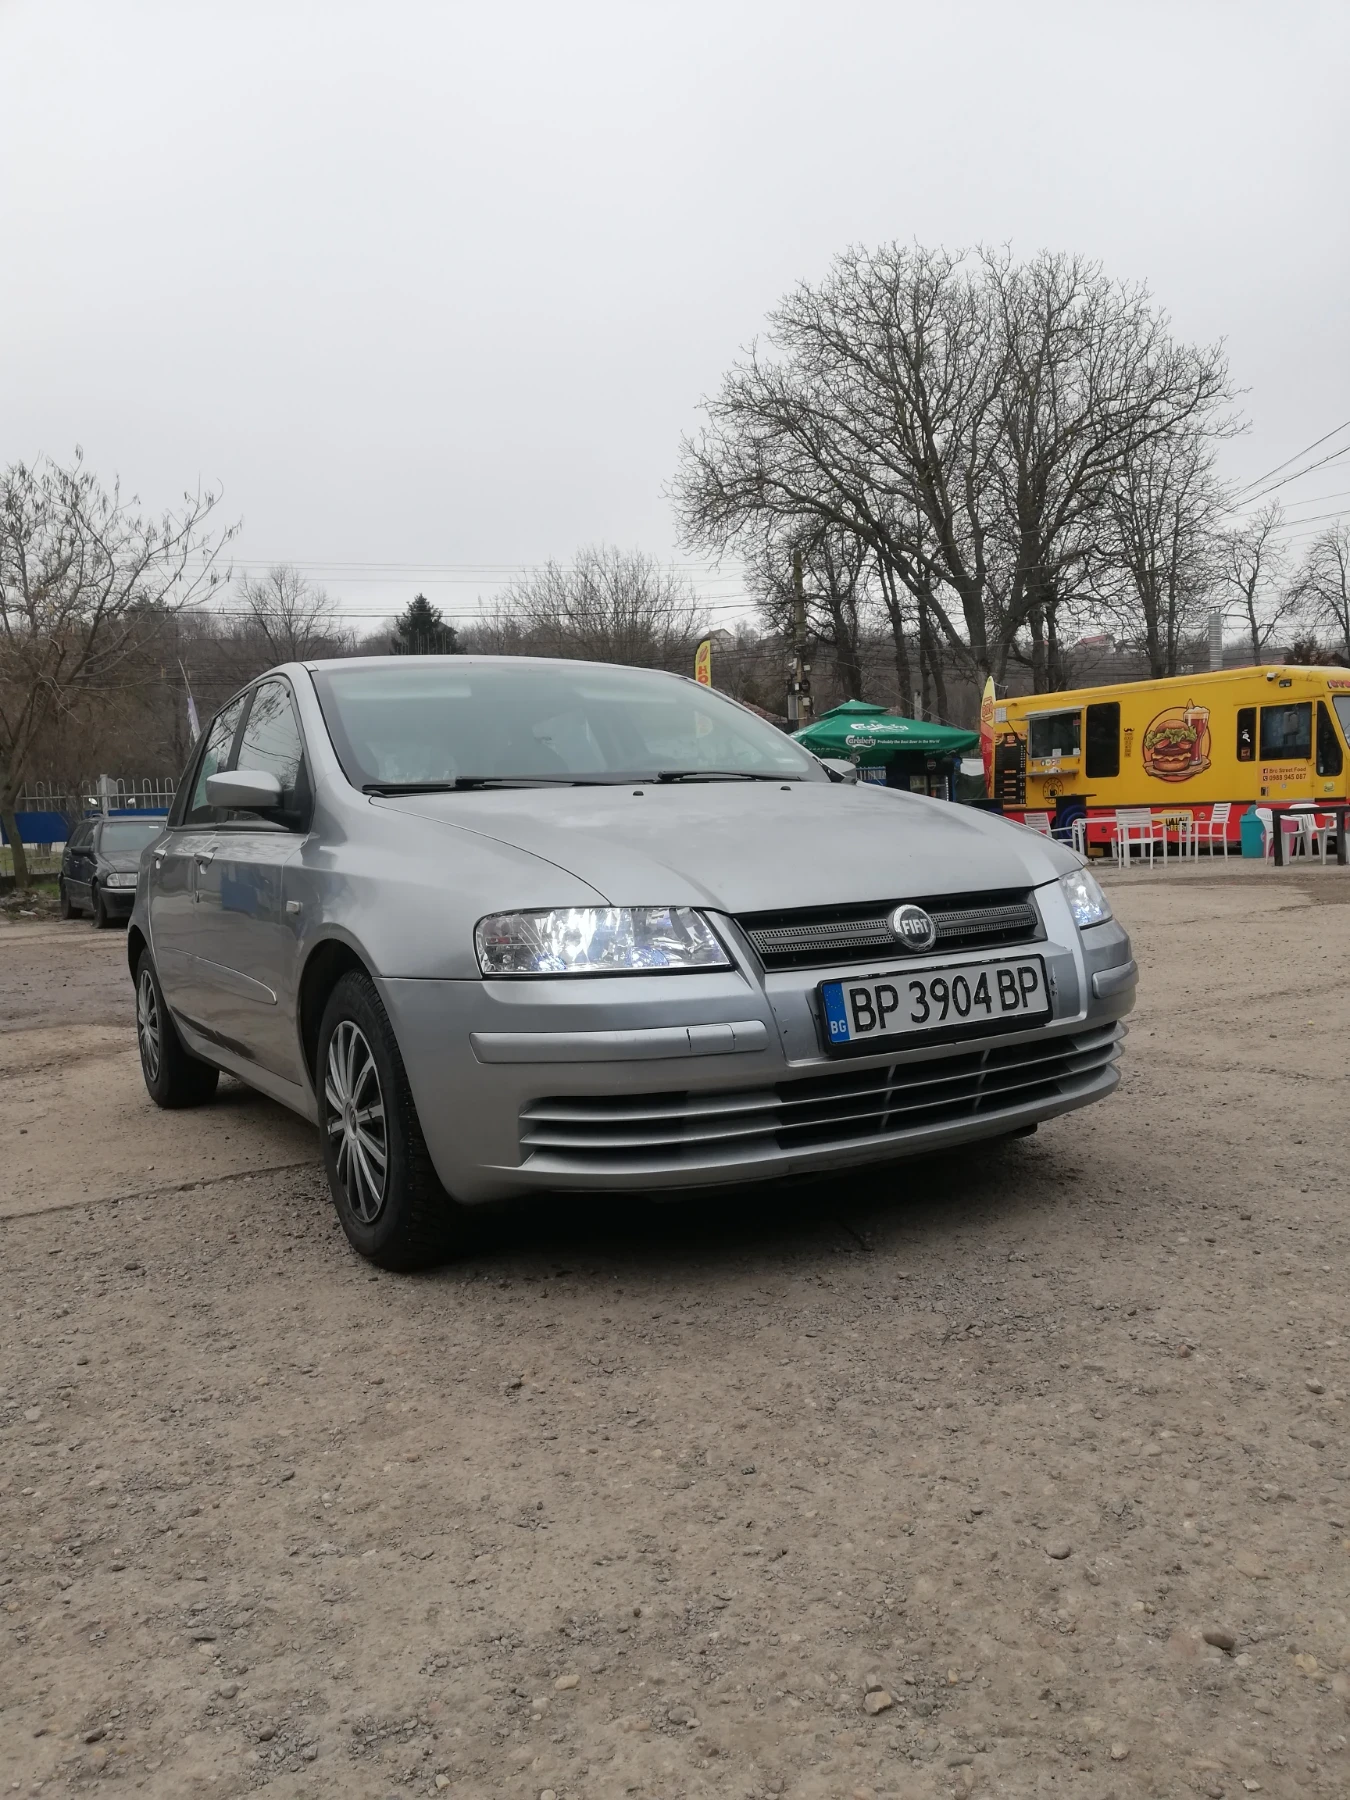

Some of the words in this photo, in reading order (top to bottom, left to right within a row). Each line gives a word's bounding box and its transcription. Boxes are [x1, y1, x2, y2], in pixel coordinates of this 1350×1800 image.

[698, 666, 709, 685] HO
[846, 735, 876, 748] Carlsberg
[901, 919, 929, 935] FIAT
[849, 984, 899, 1033] BP
[909, 971, 993, 1024] 3904
[996, 966, 1038, 1012] BP
[830, 1019, 847, 1034] BG
